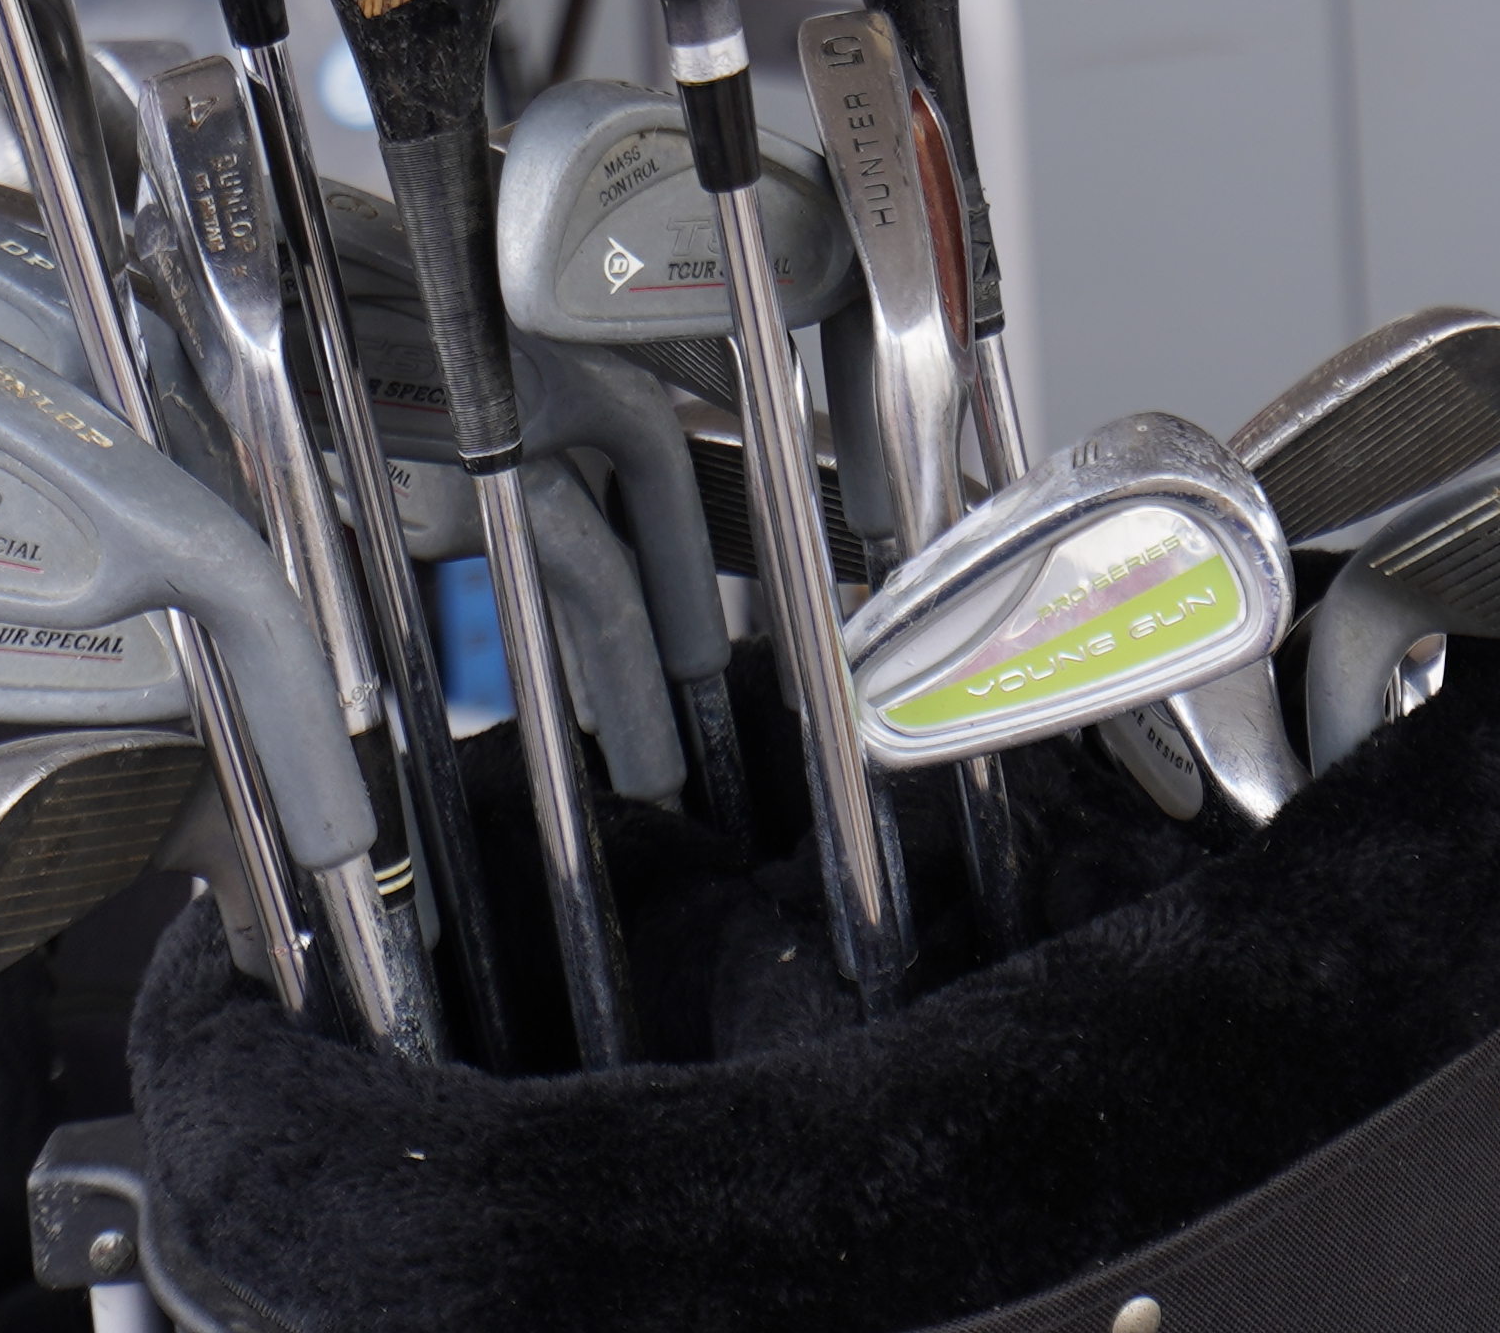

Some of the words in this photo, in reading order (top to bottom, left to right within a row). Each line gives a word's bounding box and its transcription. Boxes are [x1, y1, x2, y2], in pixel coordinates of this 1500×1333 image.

[820, 35, 865, 70] 5
[181, 93, 221, 132] 4
[599, 158, 661, 208] CONTROL
[604, 145, 642, 179] MASS
[842, 91, 897, 228] HUNTER
[211, 153, 258, 254] DUNLOP
[1037, 583, 1088, 622] PRO
[1092, 533, 1182, 590] SERIES
[34, 630, 125, 655] SPECIAL
[966, 632, 1117, 700] YOUNG
[1128, 587, 1218, 641] GUN
[1146, 727, 1194, 776] DESIGN
